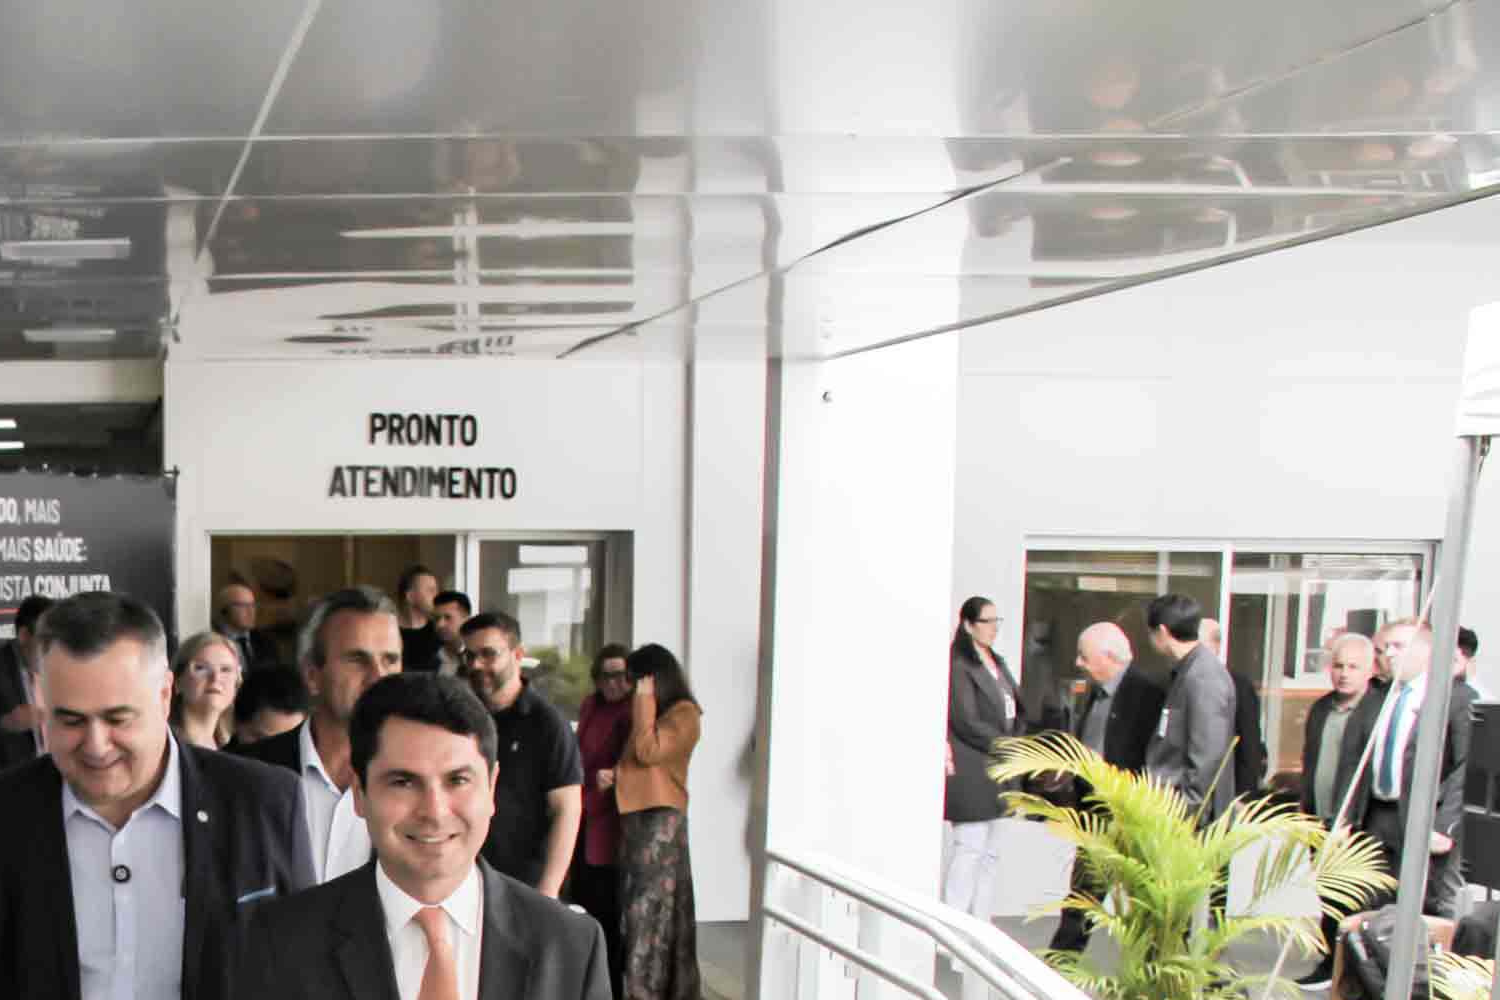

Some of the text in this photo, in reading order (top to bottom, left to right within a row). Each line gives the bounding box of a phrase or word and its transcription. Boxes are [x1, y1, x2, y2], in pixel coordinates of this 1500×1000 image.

[368, 412, 478, 447] PRONTO
[328, 465, 517, 499] ATENDIMENTO
[24, 498, 61, 524] MAIS
